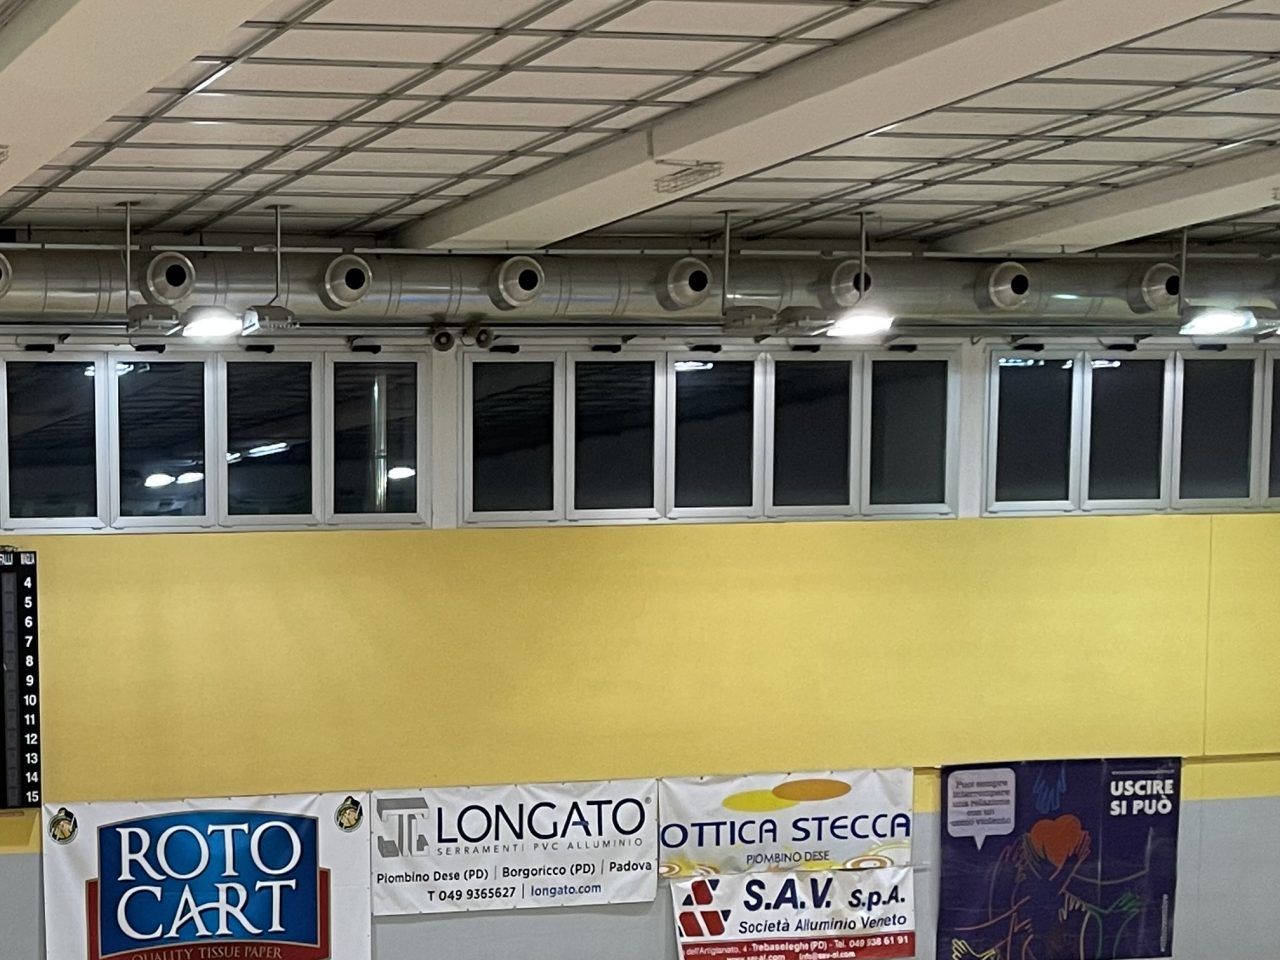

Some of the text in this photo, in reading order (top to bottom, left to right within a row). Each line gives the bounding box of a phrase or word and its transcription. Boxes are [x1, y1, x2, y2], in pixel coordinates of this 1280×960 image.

[24, 578, 32, 588] 4
[24, 597, 32, 607] 5
[25, 617, 32, 627] 6
[25, 637, 32, 647] 7
[26, 656, 33, 666] 8
[26, 675, 34, 685] 9
[24, 695, 36, 705] 10
[24, 715, 35, 725] 11
[25, 734, 37, 744] 12
[26, 753, 38, 764] 13
[26, 773, 38, 783] 14
[1111, 780, 1173, 796] USCIRE
[27, 791, 39, 802] 15
[1110, 795, 1172, 816] SI PUÒ
[437, 798, 645, 843] LONGATO
[660, 813, 910, 848] OTTICA STECCA
[117, 821, 301, 881] ROTO
[437, 838, 643, 855] SERRAMENTI PVC ALLUMINIO
[747, 851, 829, 864] PIOMBINO DESE
[377, 859, 651, 884] Piombino Dese (PD) Borgoricco (PD) Padova
[428, 883, 601, 901] T 049 9365627 longato.com
[743, 878, 832, 911] S.A.V.
[117, 880, 295, 939] CART
[739, 914, 906, 935] Società Alluminio Veneto
[884, 936, 895, 945] 61
[897, 935, 908, 944] 91
[199, 946, 240, 958] TISSUE
[245, 946, 282, 958] PAPER
